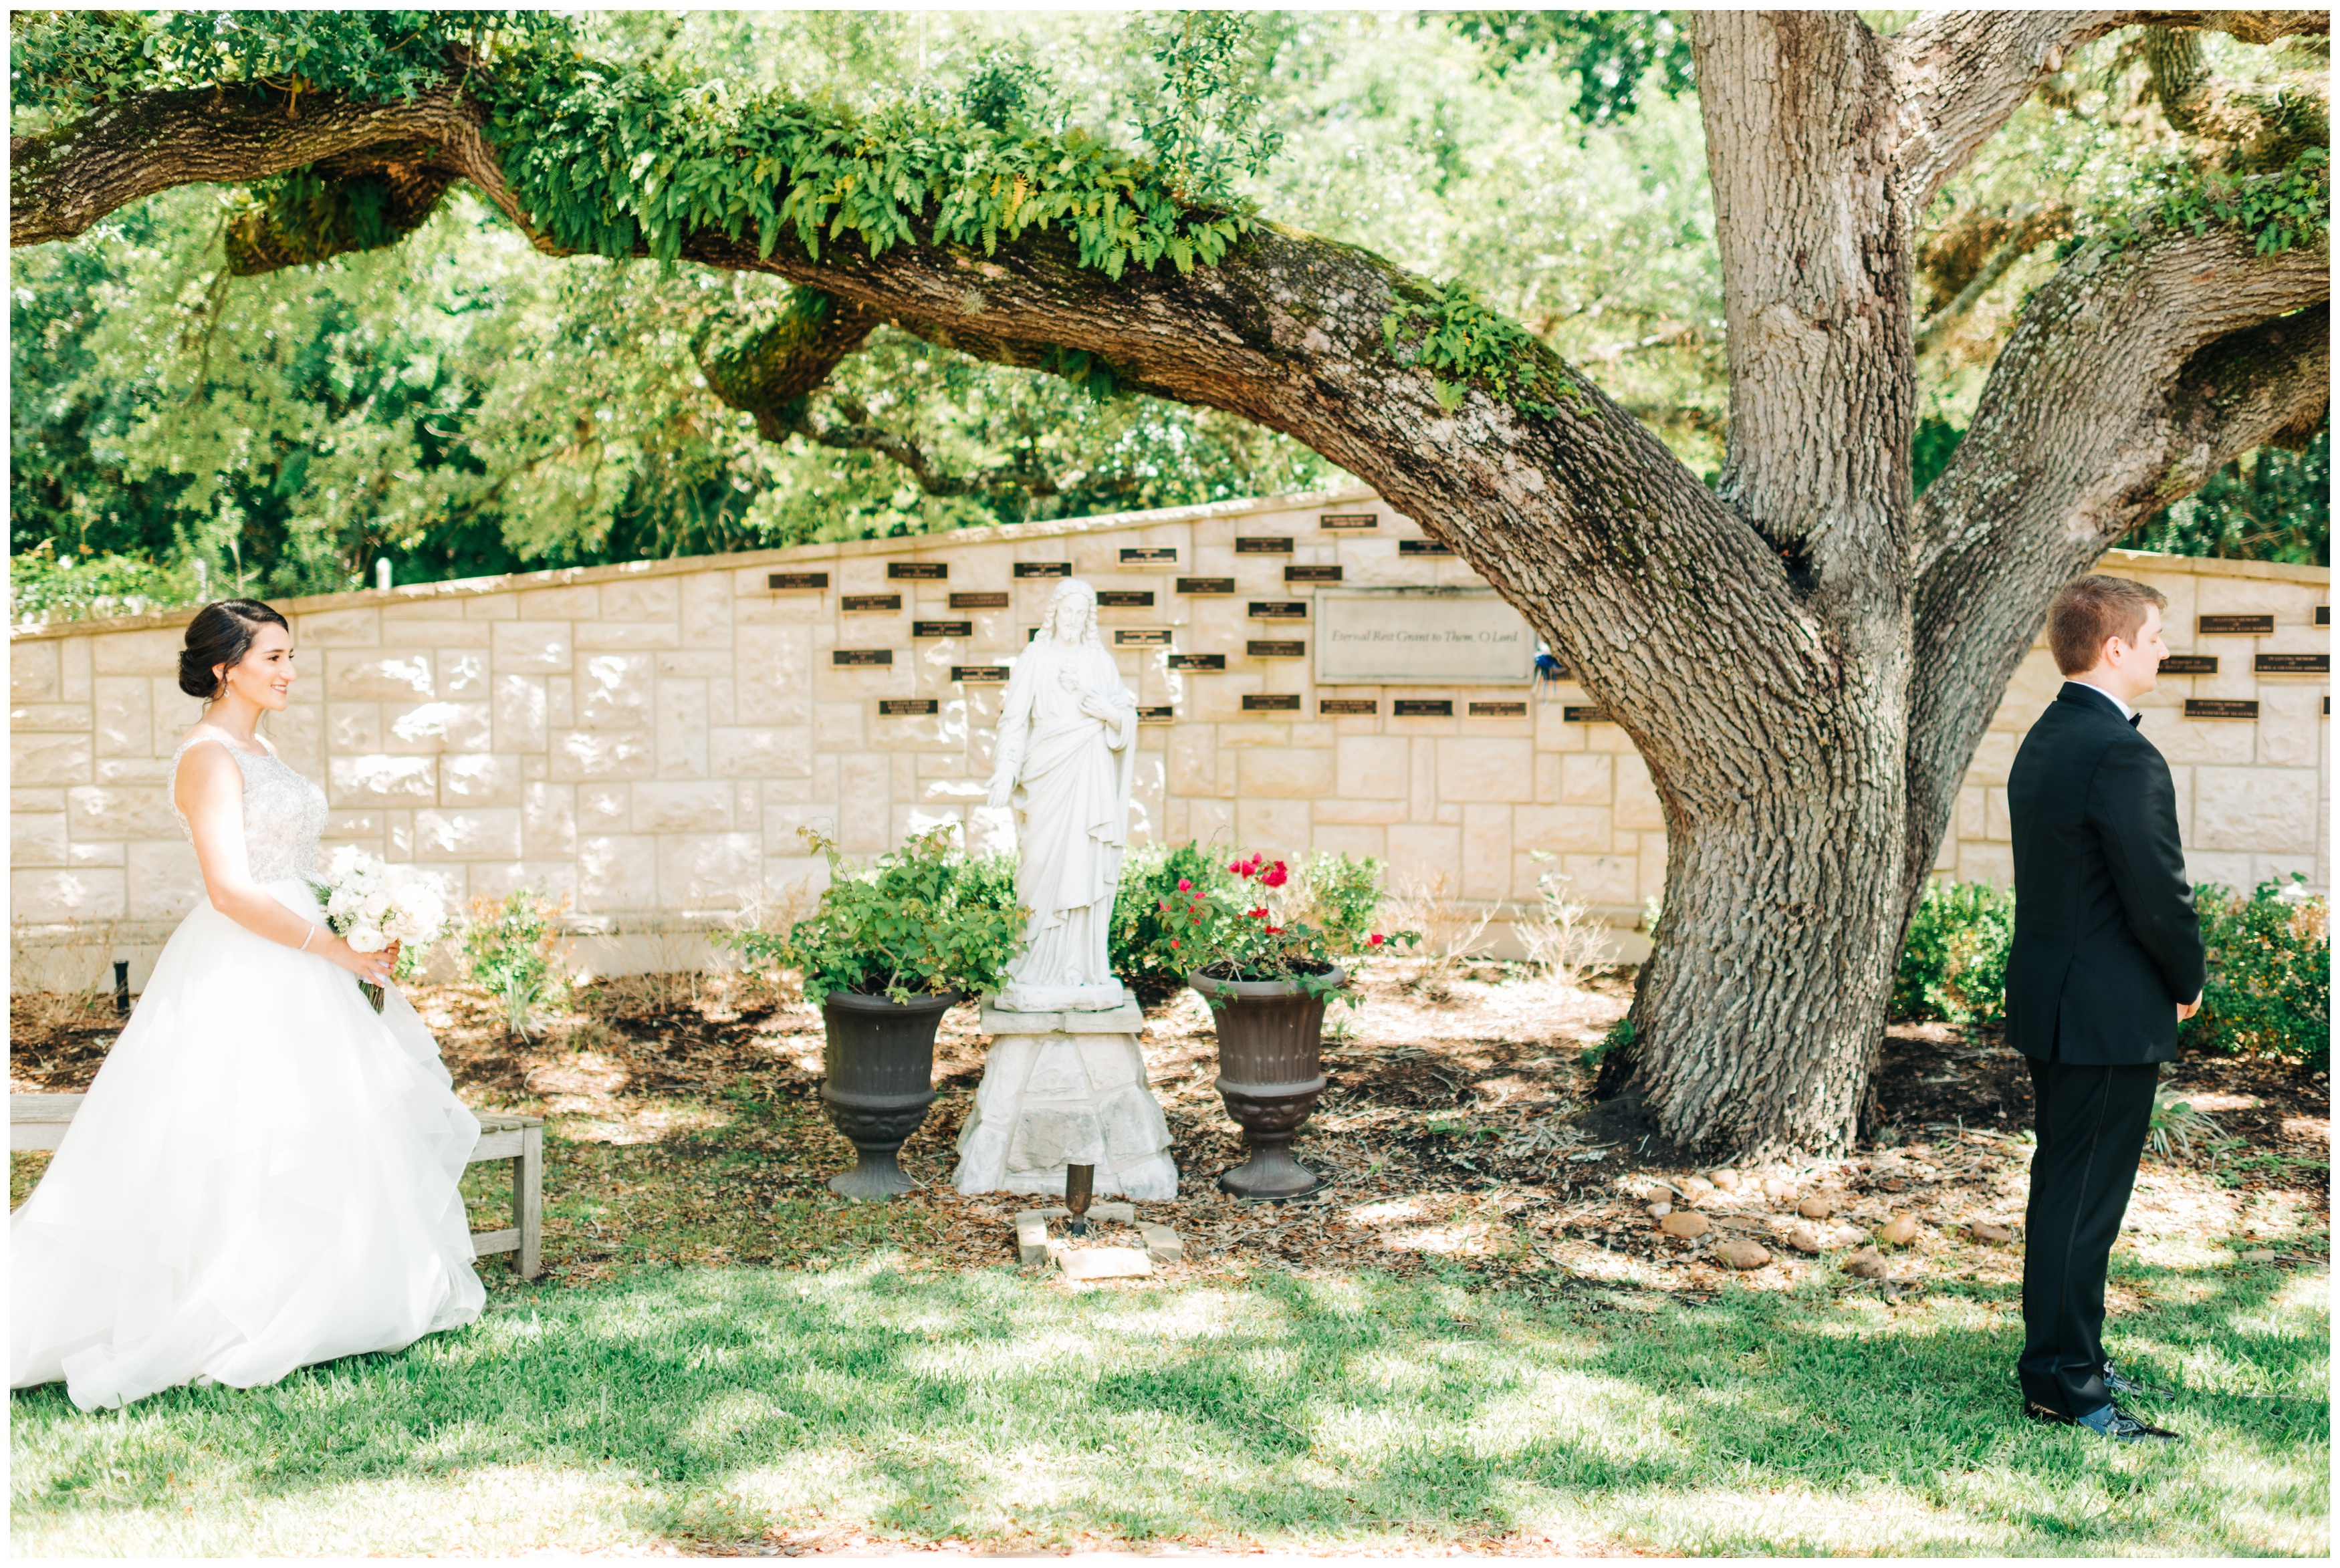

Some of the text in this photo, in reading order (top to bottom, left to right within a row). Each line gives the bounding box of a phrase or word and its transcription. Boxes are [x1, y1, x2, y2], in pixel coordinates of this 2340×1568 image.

[1331, 631, 1370, 643] Eternal
[1373, 631, 1394, 643] Rest
[1397, 630, 1429, 642] Grant
[1432, 632, 1441, 642] to
[1444, 631, 1476, 644] Them,
[1479, 631, 1491, 642] O
